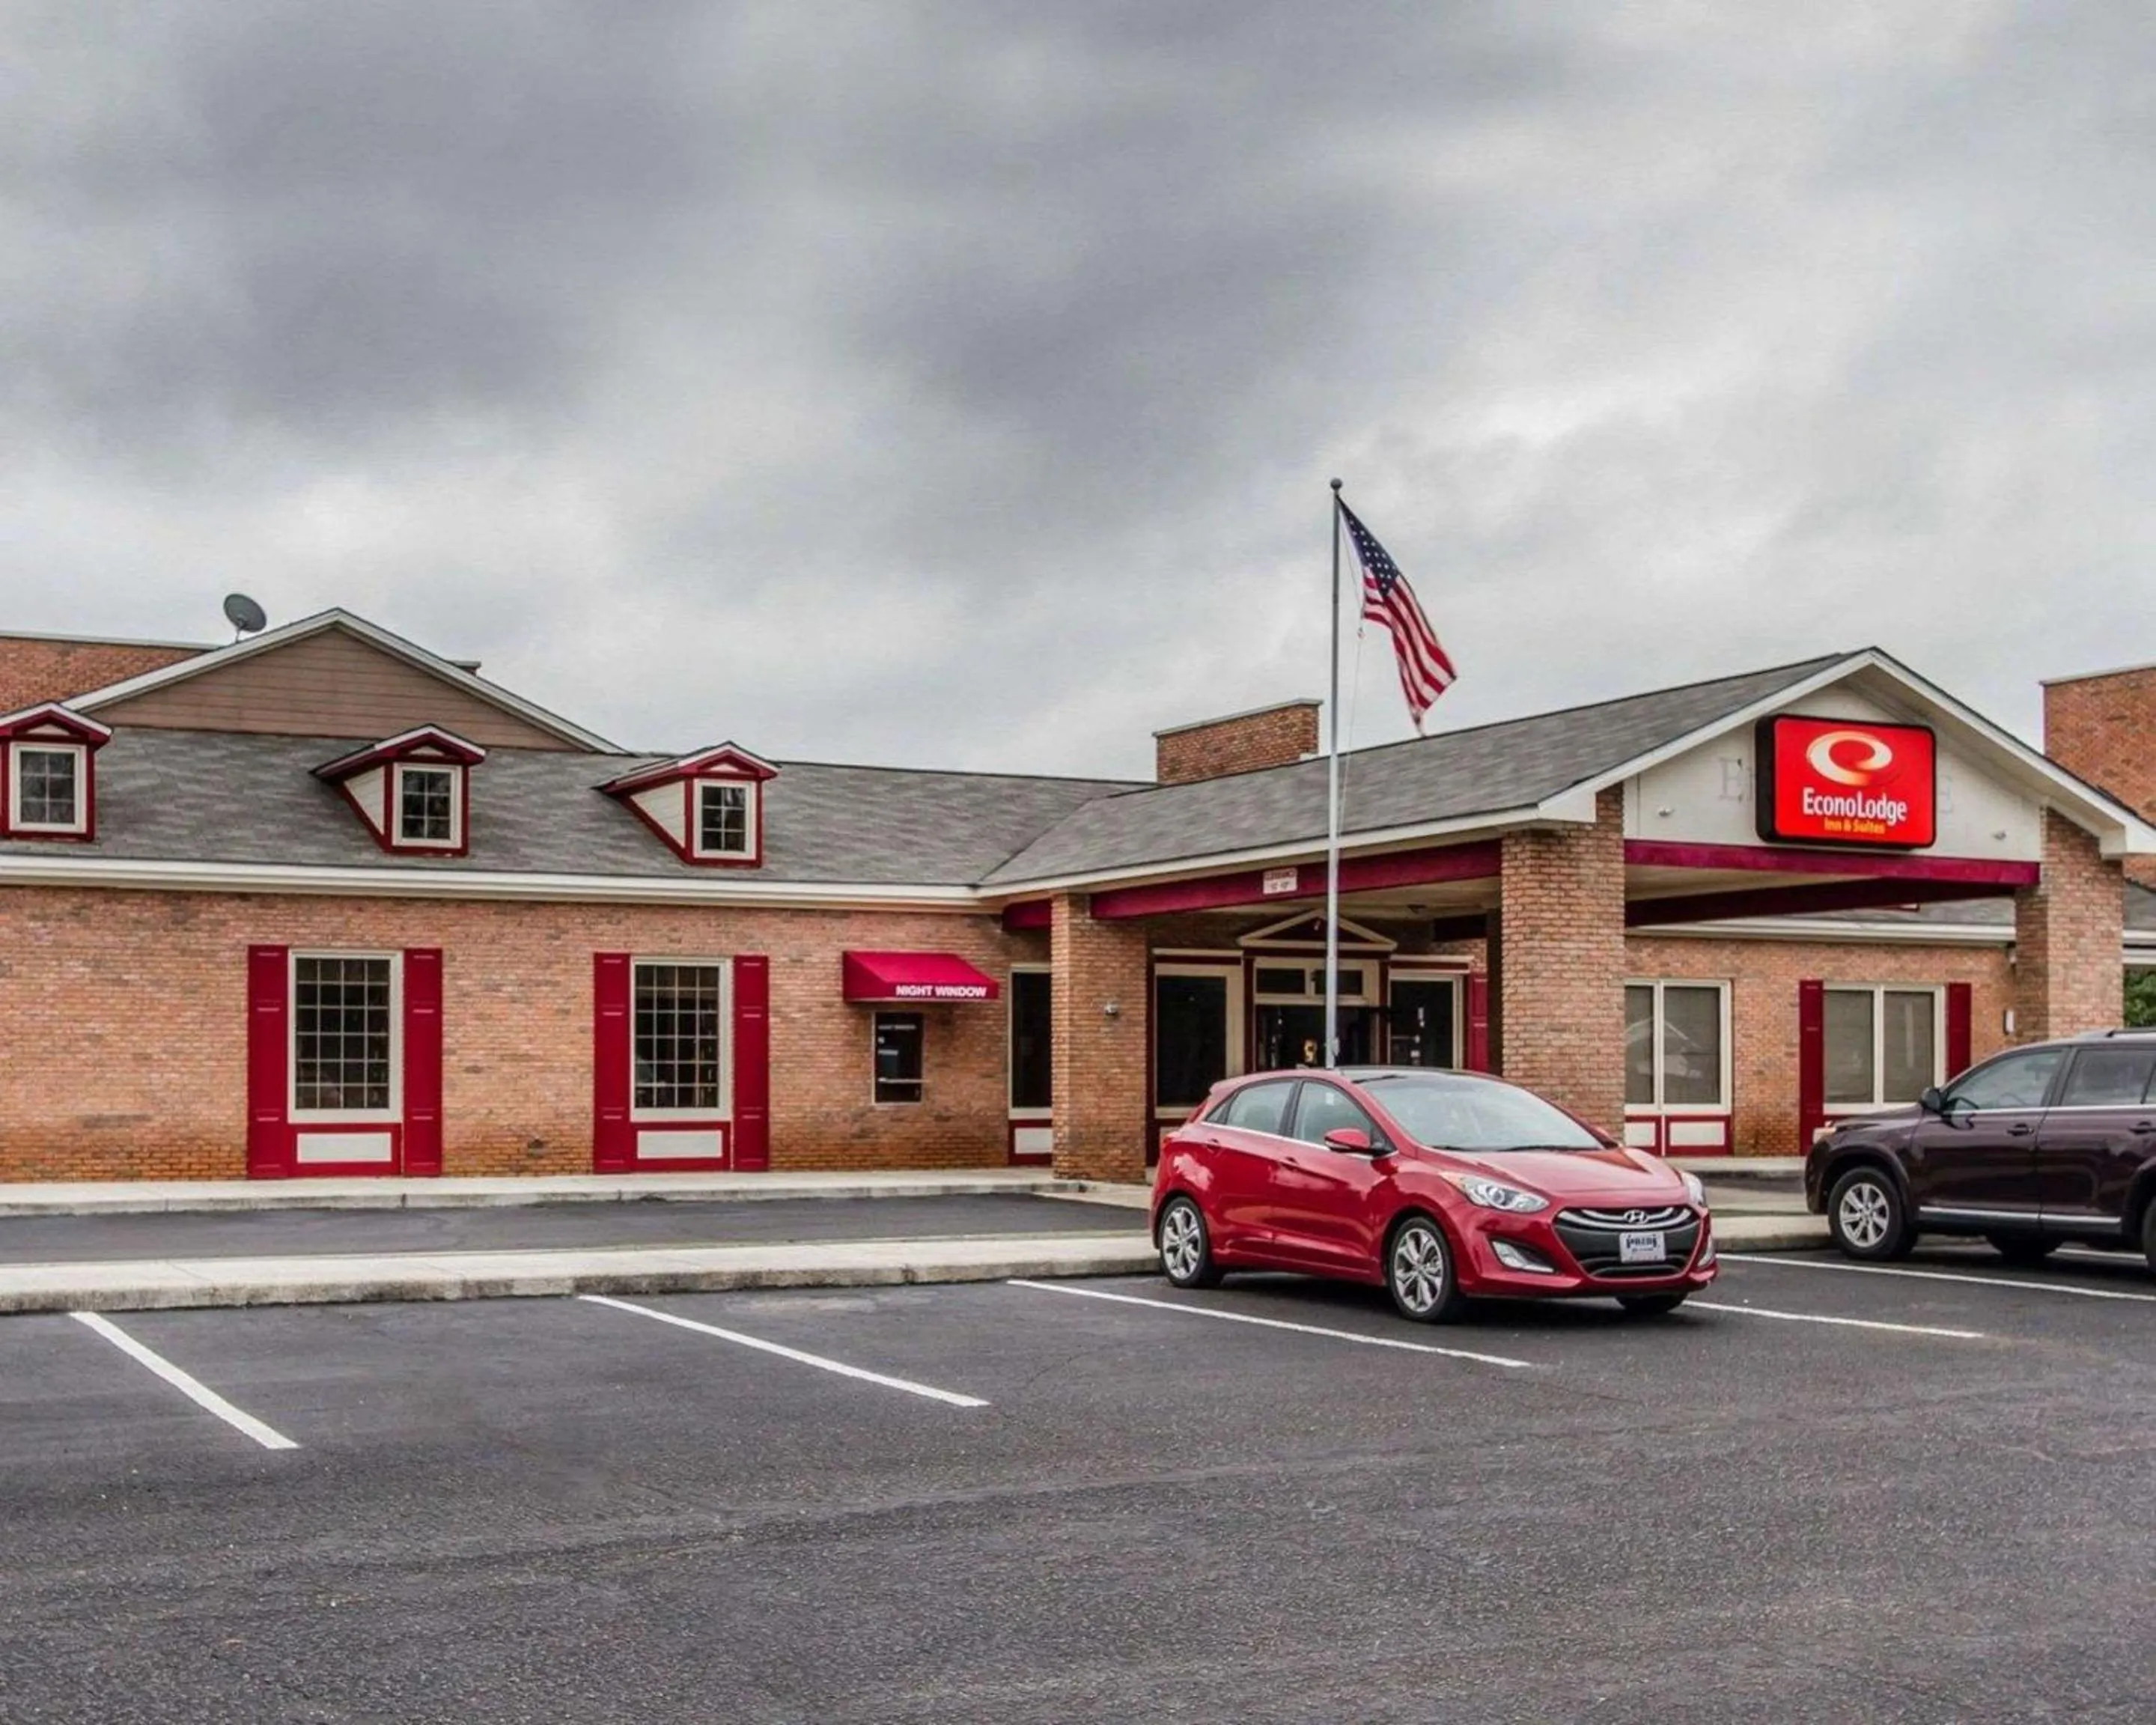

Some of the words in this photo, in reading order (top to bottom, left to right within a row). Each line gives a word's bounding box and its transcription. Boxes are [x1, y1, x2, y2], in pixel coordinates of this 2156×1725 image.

[1803, 787, 1908, 826] EconoLodge
[1824, 818, 1842, 831] Inn
[1844, 820, 1852, 832] &
[1853, 819, 1886, 834] Suites
[896, 985, 934, 997] NIGHT
[935, 985, 987, 997] WINDOW
